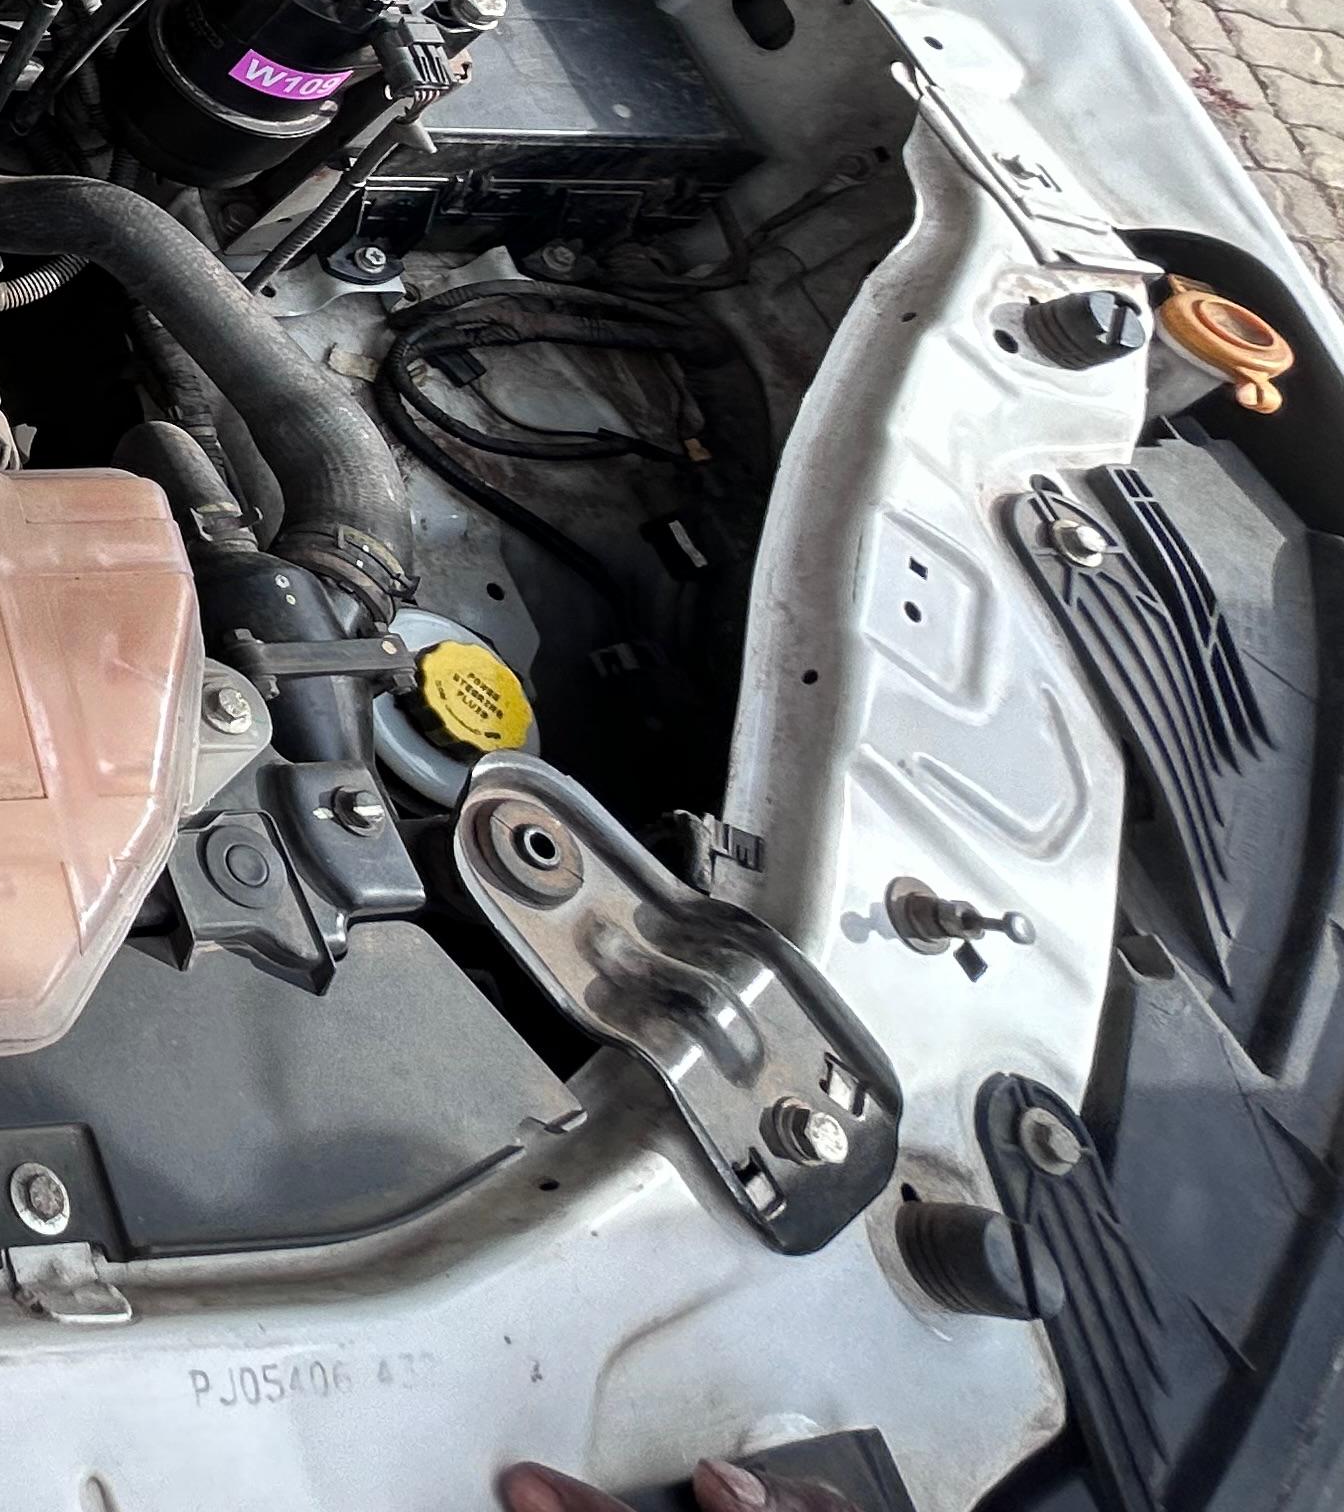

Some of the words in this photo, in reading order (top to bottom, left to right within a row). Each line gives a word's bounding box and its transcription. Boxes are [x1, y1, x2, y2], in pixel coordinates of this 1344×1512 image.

[245, 58, 342, 96] W109
[452, 672, 504, 720] STEERING
[467, 672, 500, 702] POWER
[457, 690, 489, 719] FLUID
